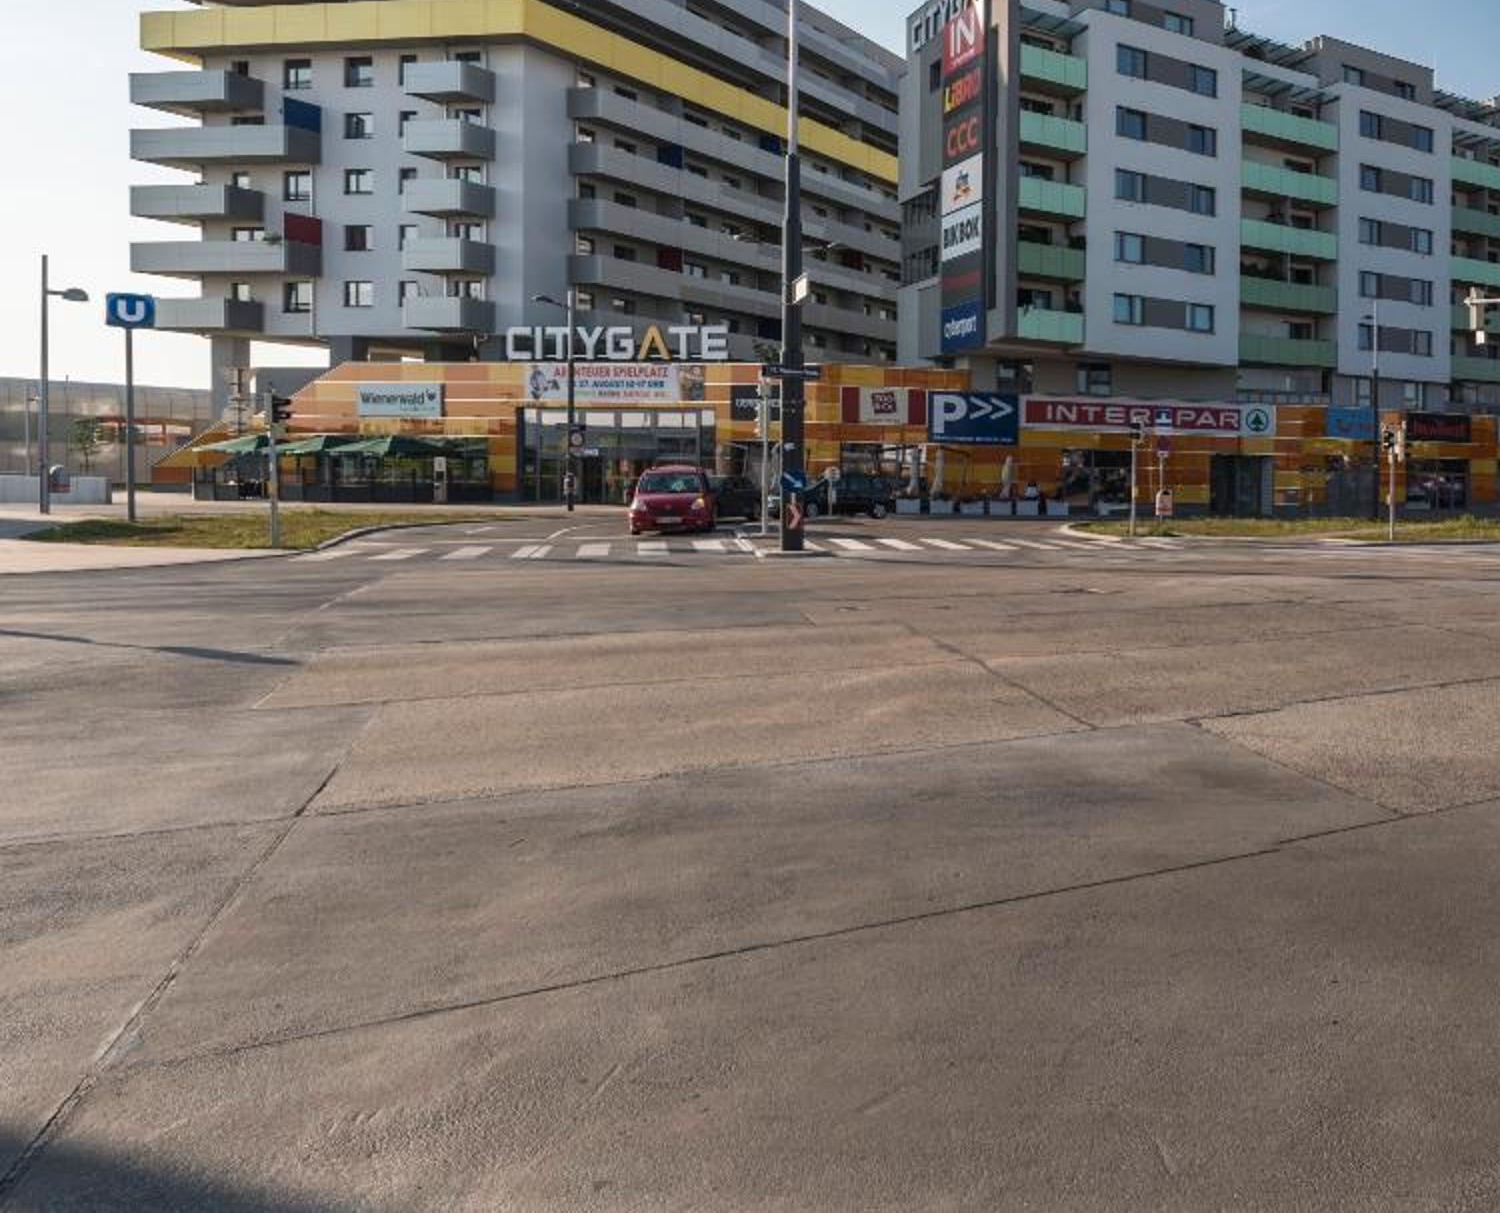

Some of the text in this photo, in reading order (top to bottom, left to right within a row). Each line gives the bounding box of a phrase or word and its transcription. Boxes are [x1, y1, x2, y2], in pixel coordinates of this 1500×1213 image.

[949, 7, 976, 58] IN
[947, 116, 977, 157] CCC
[117, 299, 145, 322] U
[506, 323, 729, 361] CITYGATE
[553, 366, 610, 378] ABNTEUER
[360, 391, 425, 405] Wienerwald
[933, 394, 967, 434] P
[1046, 404, 1239, 427] INTERPAR
